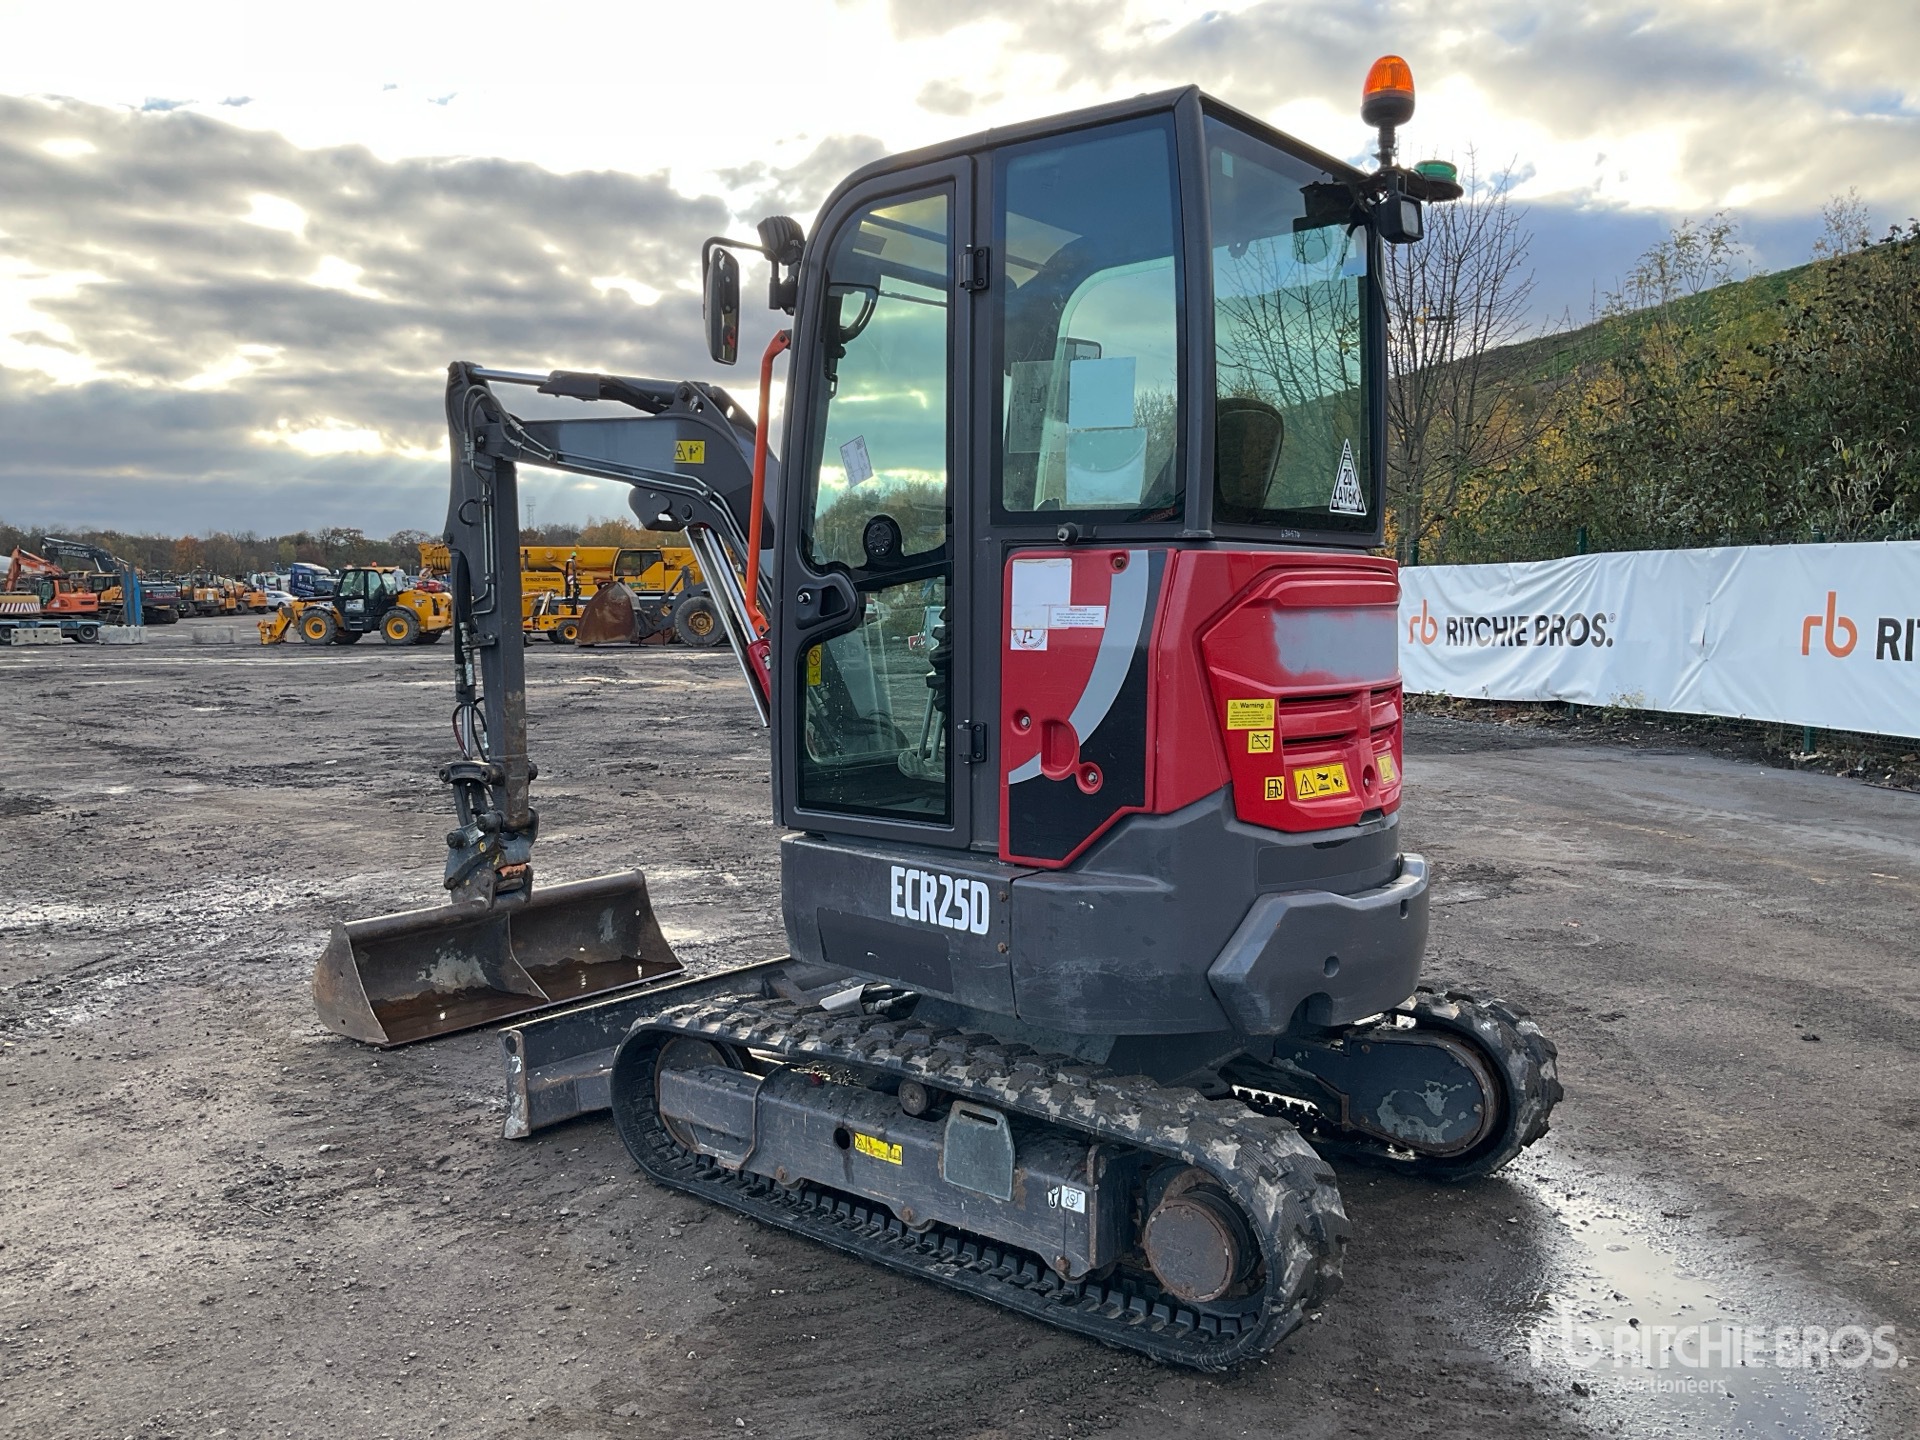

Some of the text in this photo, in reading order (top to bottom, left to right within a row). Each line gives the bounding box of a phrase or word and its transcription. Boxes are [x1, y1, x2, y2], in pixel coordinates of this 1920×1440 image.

[1408, 599, 1438, 645] rb
[1446, 615, 1530, 647] RITCHIE
[1802, 591, 1920, 662] rb RI
[891, 865, 989, 935] ECR25D
